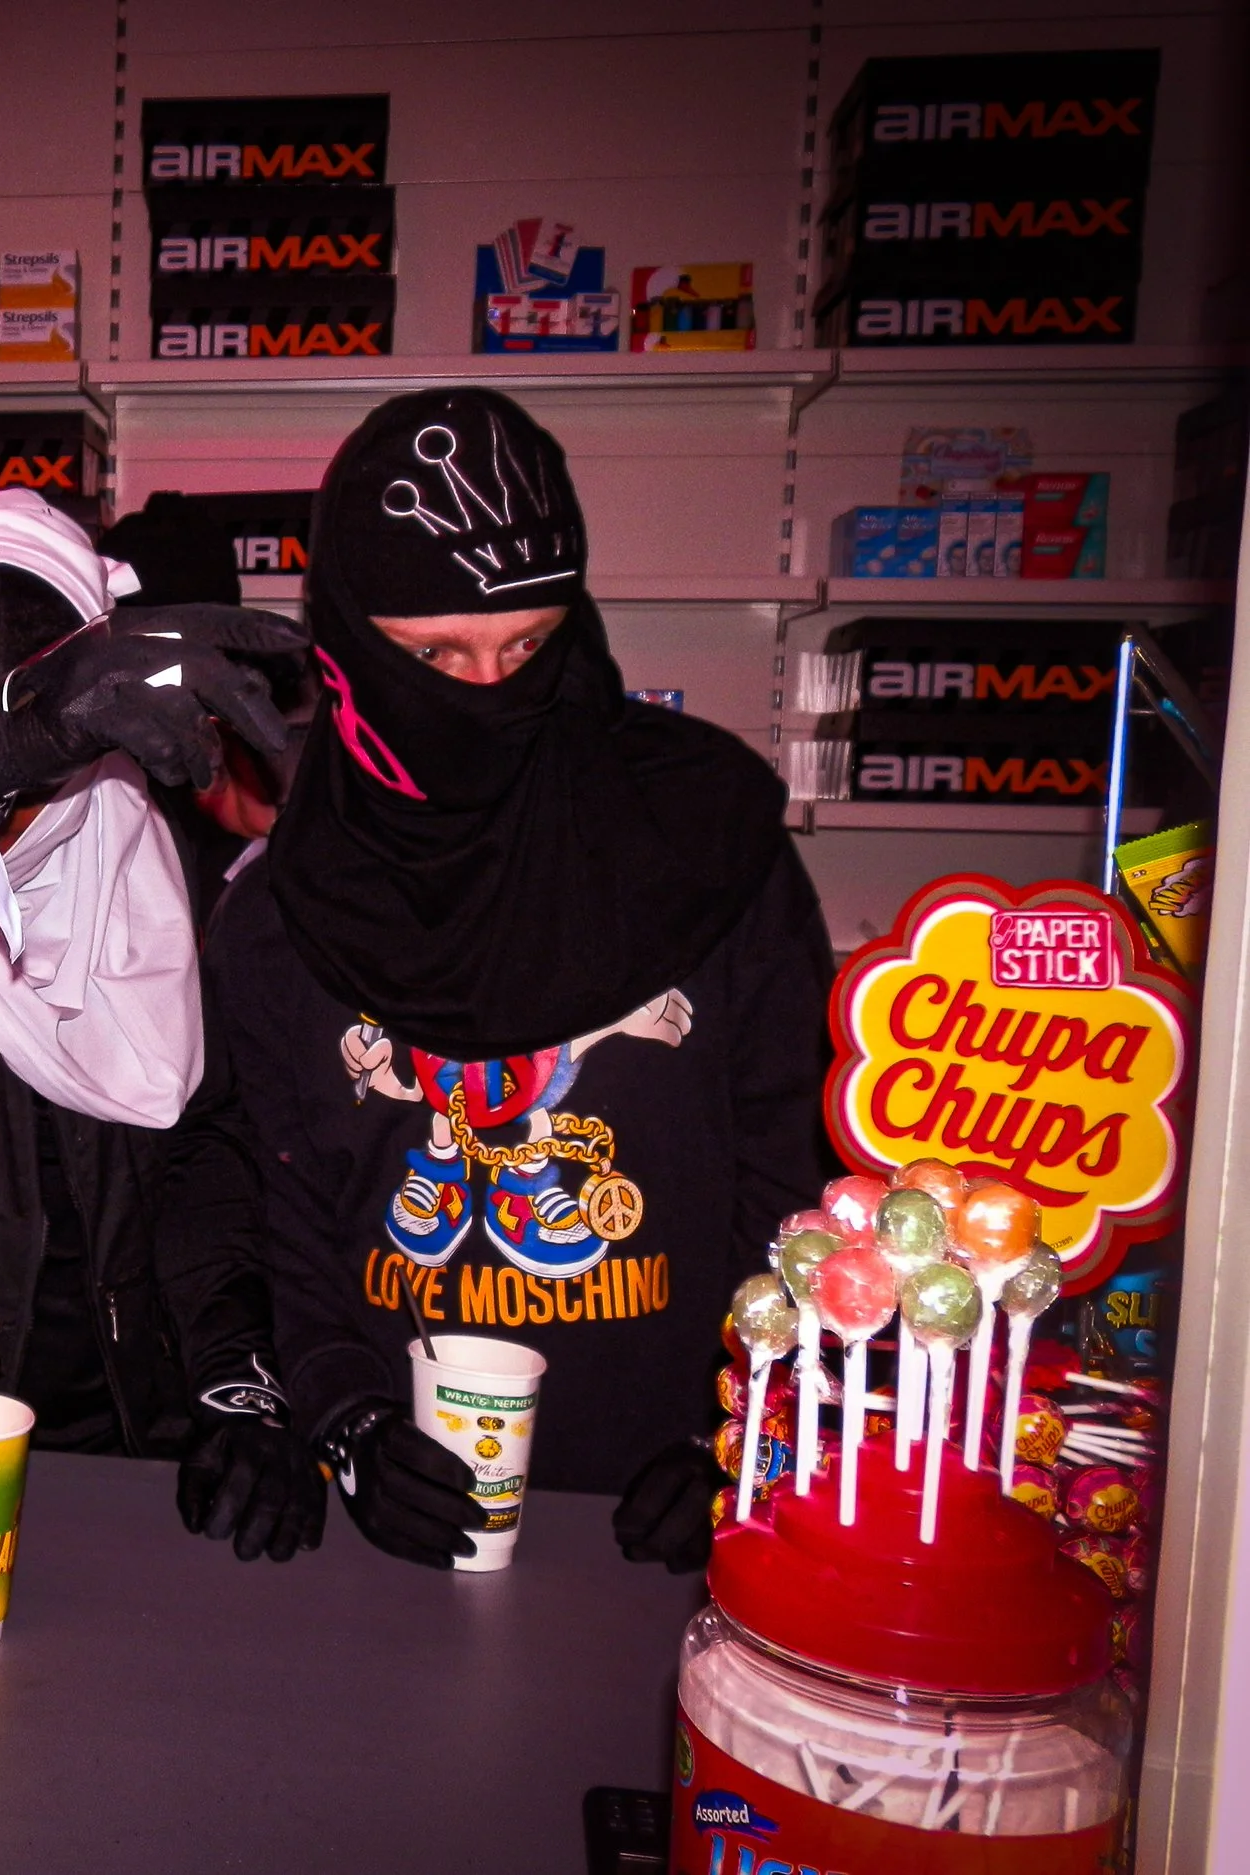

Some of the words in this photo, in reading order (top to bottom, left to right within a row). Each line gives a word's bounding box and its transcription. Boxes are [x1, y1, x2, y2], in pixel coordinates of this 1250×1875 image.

[5, 253, 59, 266] Strepsils
[3, 311, 58, 325] Strepsils
[1016, 919, 1100, 948] PAPER
[1001, 950, 1101, 984] STICK
[889, 974, 1152, 1091] Chupa
[871, 1058, 1132, 1182] Chups
[362, 1247, 448, 1322] LOVE
[461, 1253, 670, 1329] MOSCHINO
[445, 1389, 477, 1405] WRAY
[471, 1461, 514, 1477] White
[695, 1803, 751, 1825] Assorted
